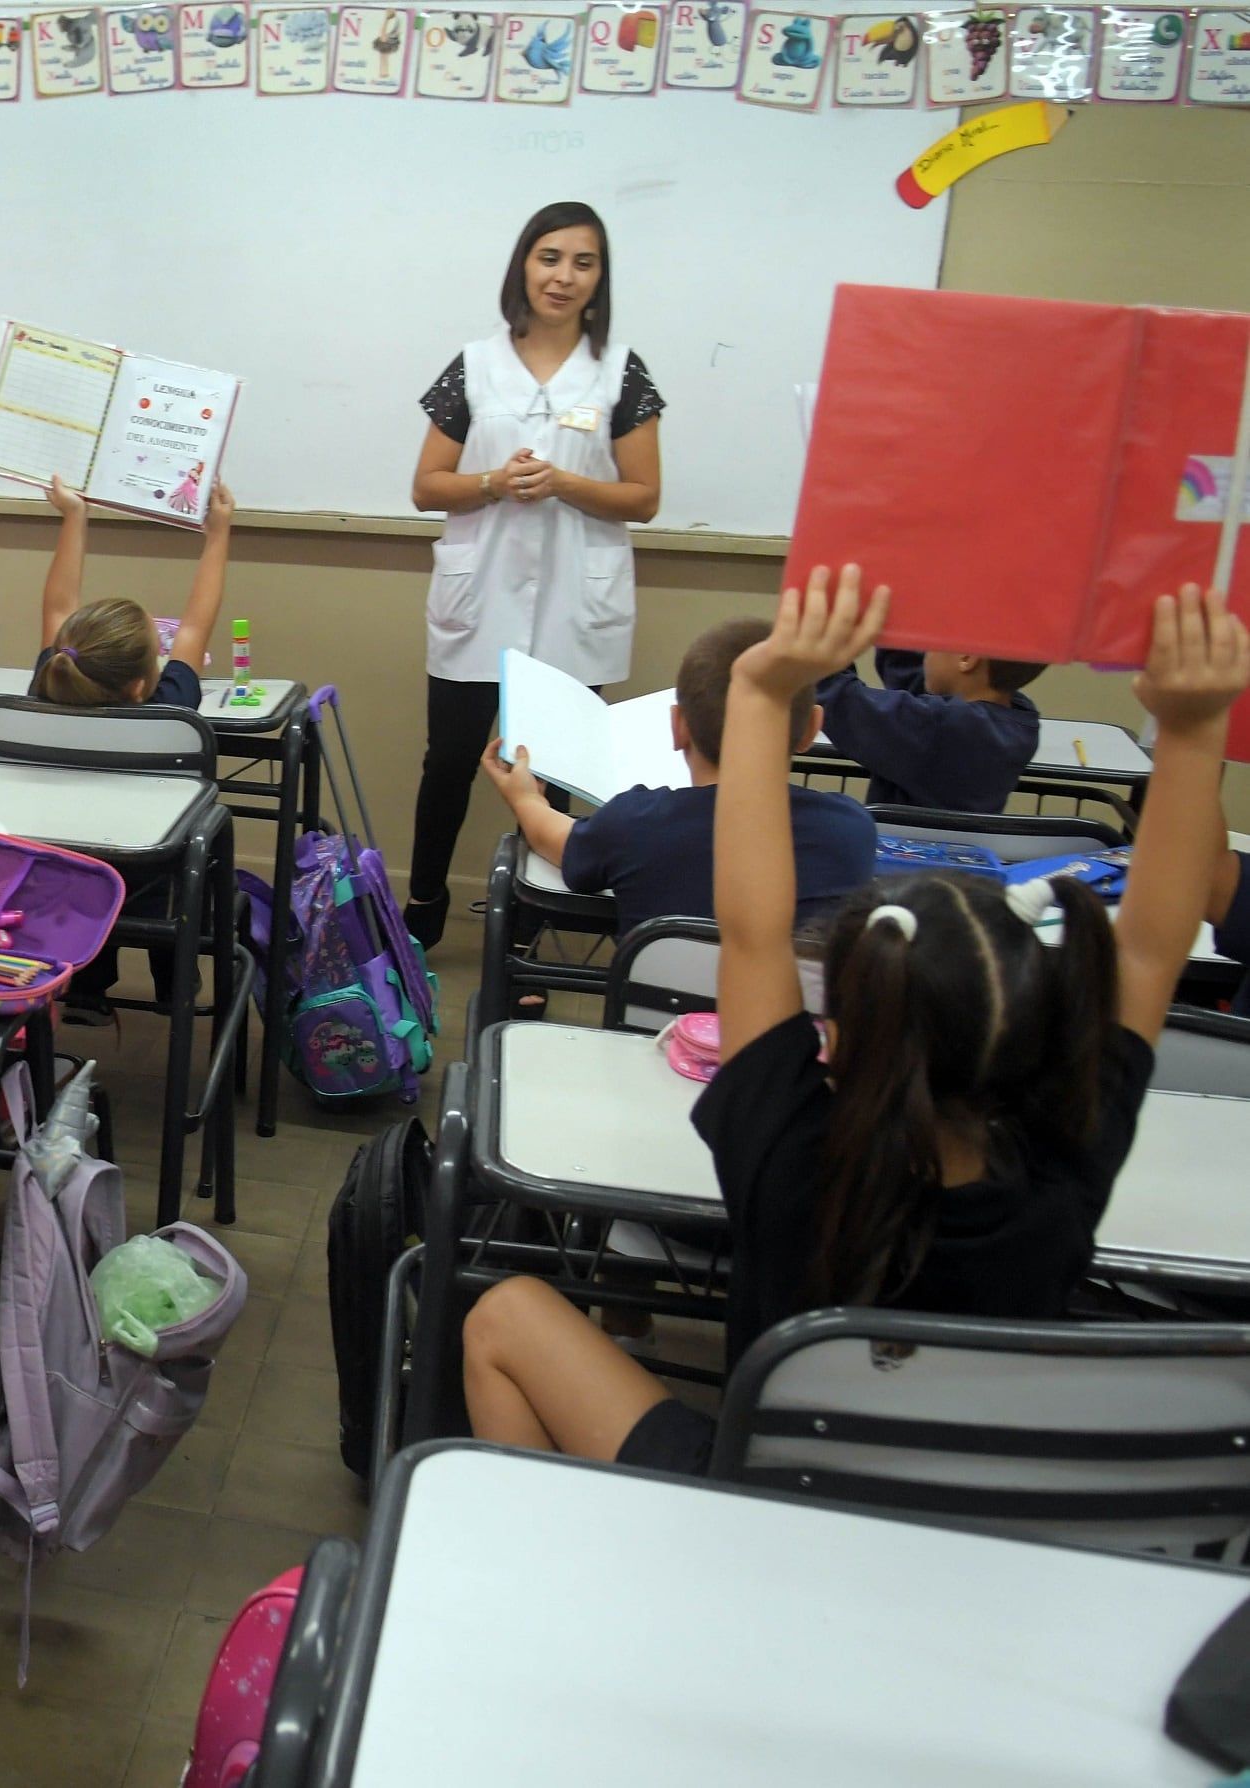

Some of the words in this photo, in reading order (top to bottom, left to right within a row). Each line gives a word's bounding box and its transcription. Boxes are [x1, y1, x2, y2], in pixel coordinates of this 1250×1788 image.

[183, 9, 204, 30] M
[676, 5, 694, 26] R
[38, 21, 54, 42] K
[110, 27, 126, 46] L
[263, 23, 282, 43] N
[426, 27, 446, 48] O
[507, 20, 524, 41] P
[591, 20, 611, 46] Q
[757, 23, 775, 45] S
[1201, 28, 1223, 49] X
[845, 34, 861, 56] T
[153, 383, 196, 399] LENGUA
[164, 402, 174, 412] Y
[126, 432, 146, 443] DEL
[147, 436, 199, 453] AMBIENTE
